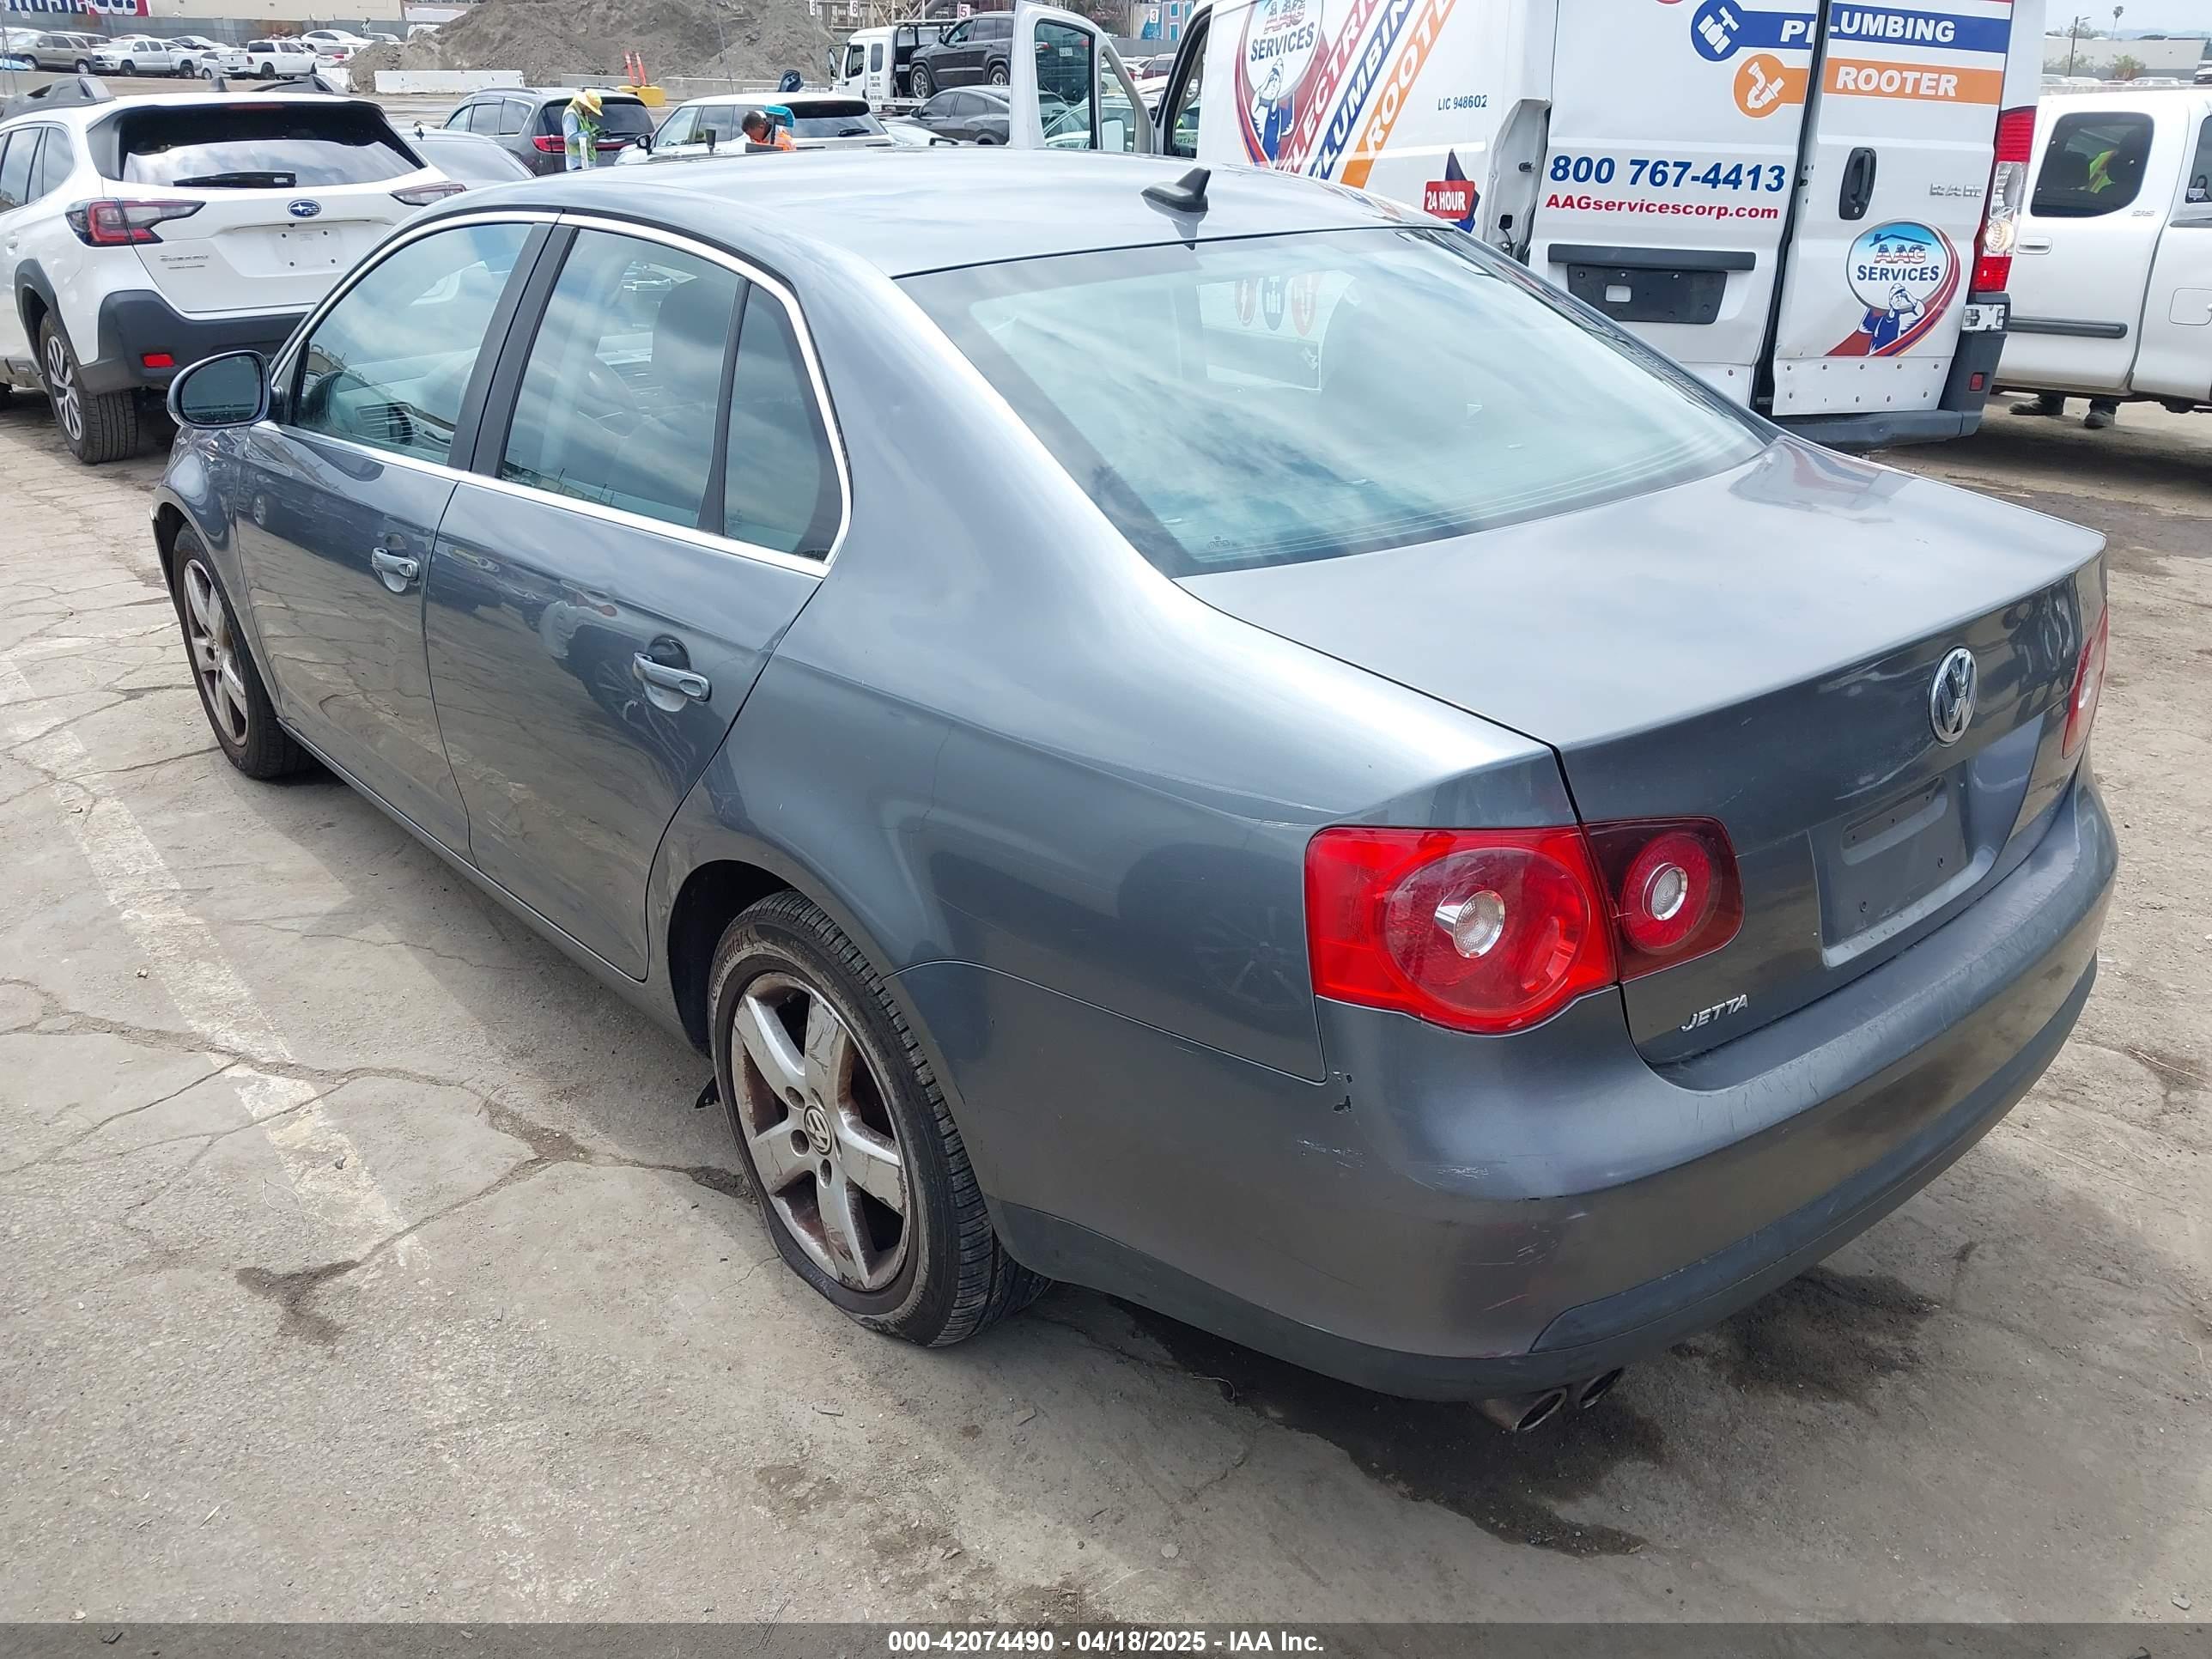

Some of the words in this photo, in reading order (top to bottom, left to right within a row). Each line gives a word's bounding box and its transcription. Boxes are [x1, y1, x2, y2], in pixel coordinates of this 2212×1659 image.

[1250, 21, 1315, 62] SERVICES
[1836, 66, 1958, 96] ROOTER
[1437, 98, 1451, 111] LIC
[1453, 94, 1487, 110] 948602
[1550, 155, 1615, 184] 800
[1629, 159, 1785, 192] 767-4413
[1426, 191, 1437, 210] 24
[1438, 191, 1467, 211] HOUR
[1546, 194, 1778, 220] AAGservicescorp.com
[1874, 244, 1926, 264] AAG
[1856, 264, 1940, 282] SERVICES
[1681, 994, 1748, 1032] JETTA
